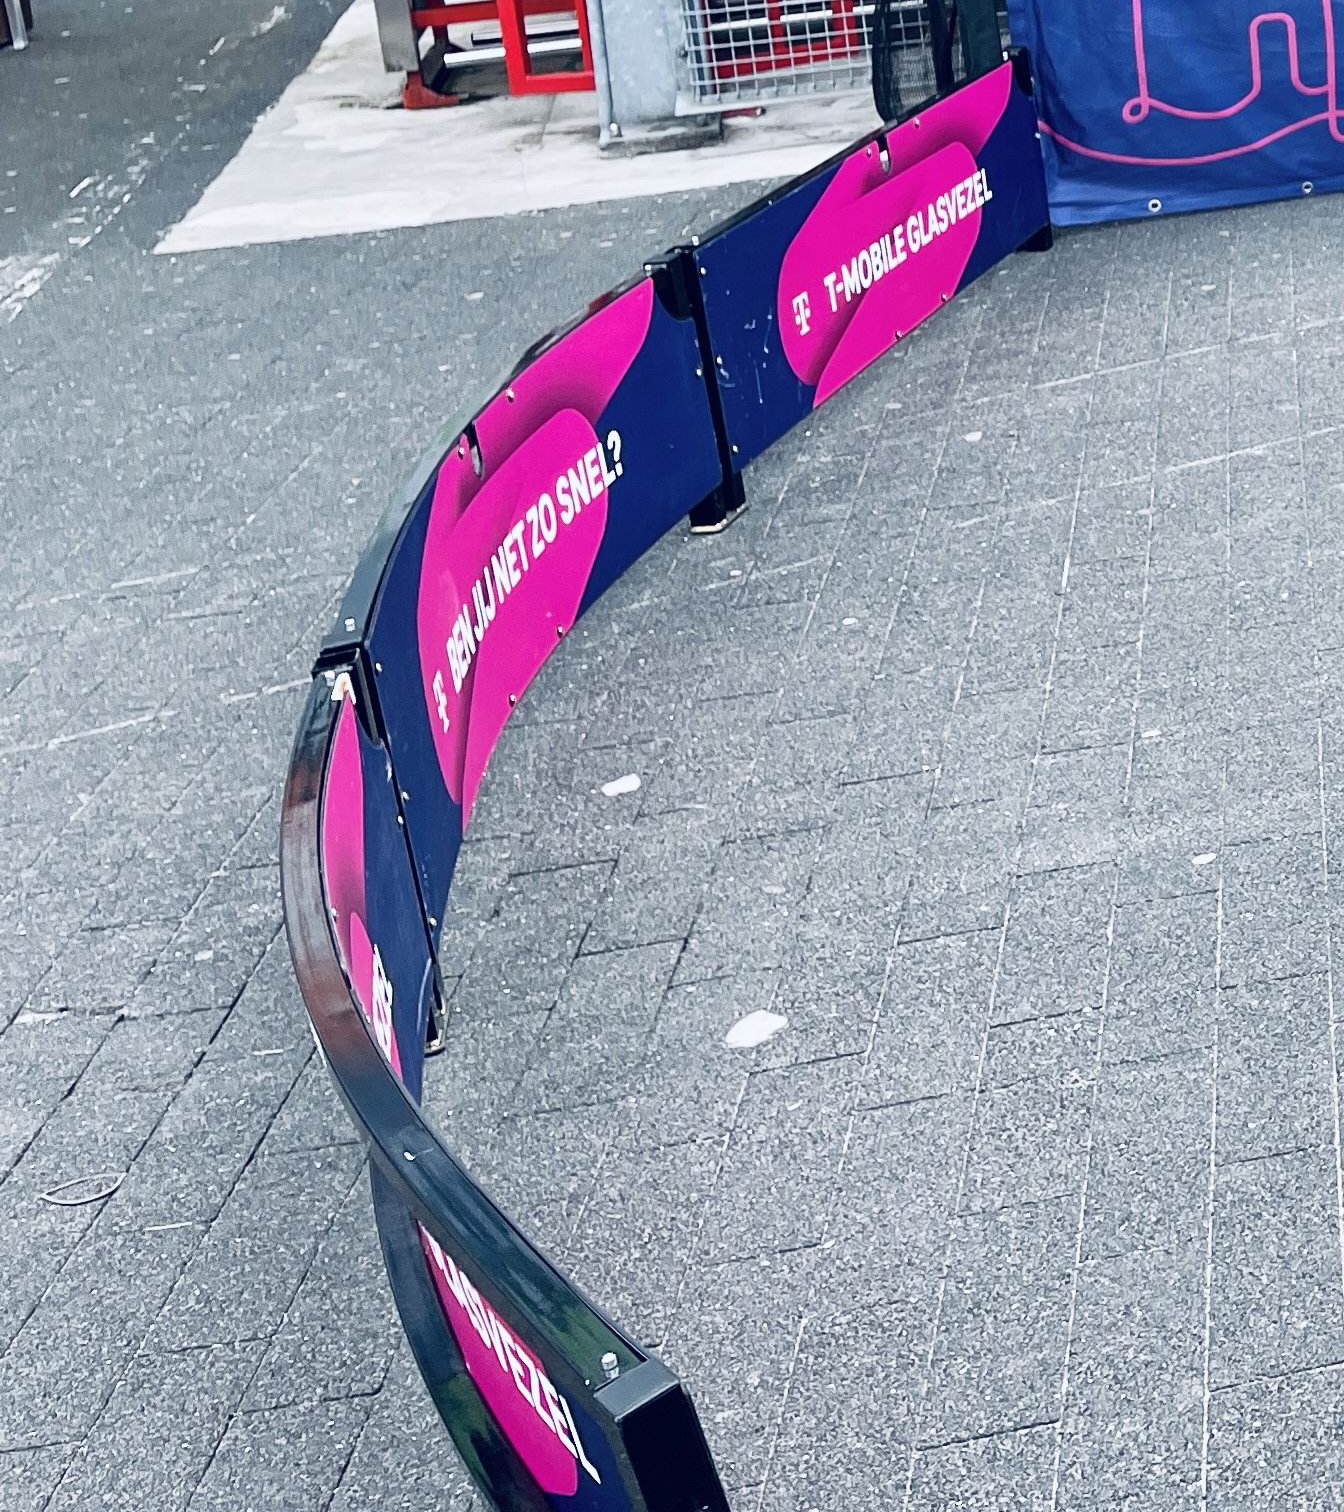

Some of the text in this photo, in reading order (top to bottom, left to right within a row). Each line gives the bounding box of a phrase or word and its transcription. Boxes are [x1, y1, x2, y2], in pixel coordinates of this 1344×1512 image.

[823, 224, 908, 313] T-MOBILE
[906, 167, 994, 254] GLASVEZEL
[445, 603, 477, 695] BEN
[472, 565, 497, 643] JIJ
[490, 519, 529, 605] NET
[525, 492, 558, 560] ZO
[555, 429, 624, 526] SNEL?
